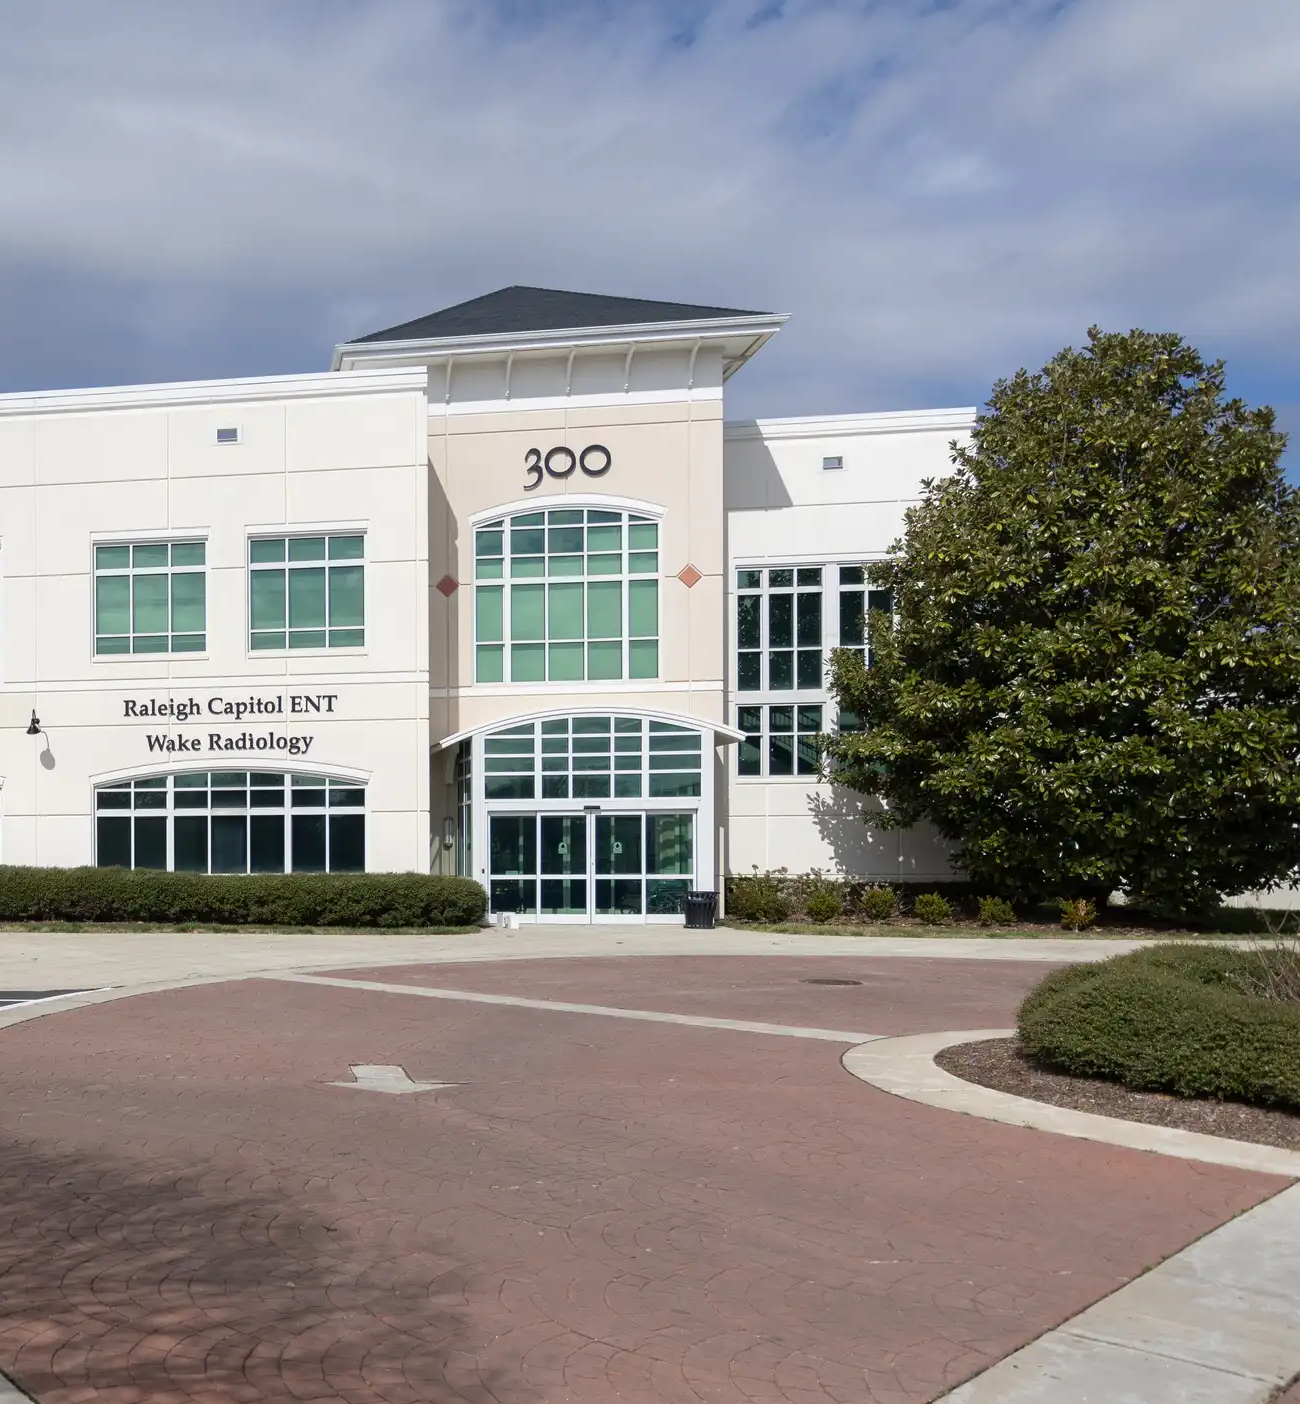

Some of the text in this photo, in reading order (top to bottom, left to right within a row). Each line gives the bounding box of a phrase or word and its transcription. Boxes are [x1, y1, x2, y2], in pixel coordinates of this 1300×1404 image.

[523, 444, 612, 491] 300
[123, 694, 338, 720] Raleigh Capitol ENT
[146, 732, 314, 754] Wake Radiology
